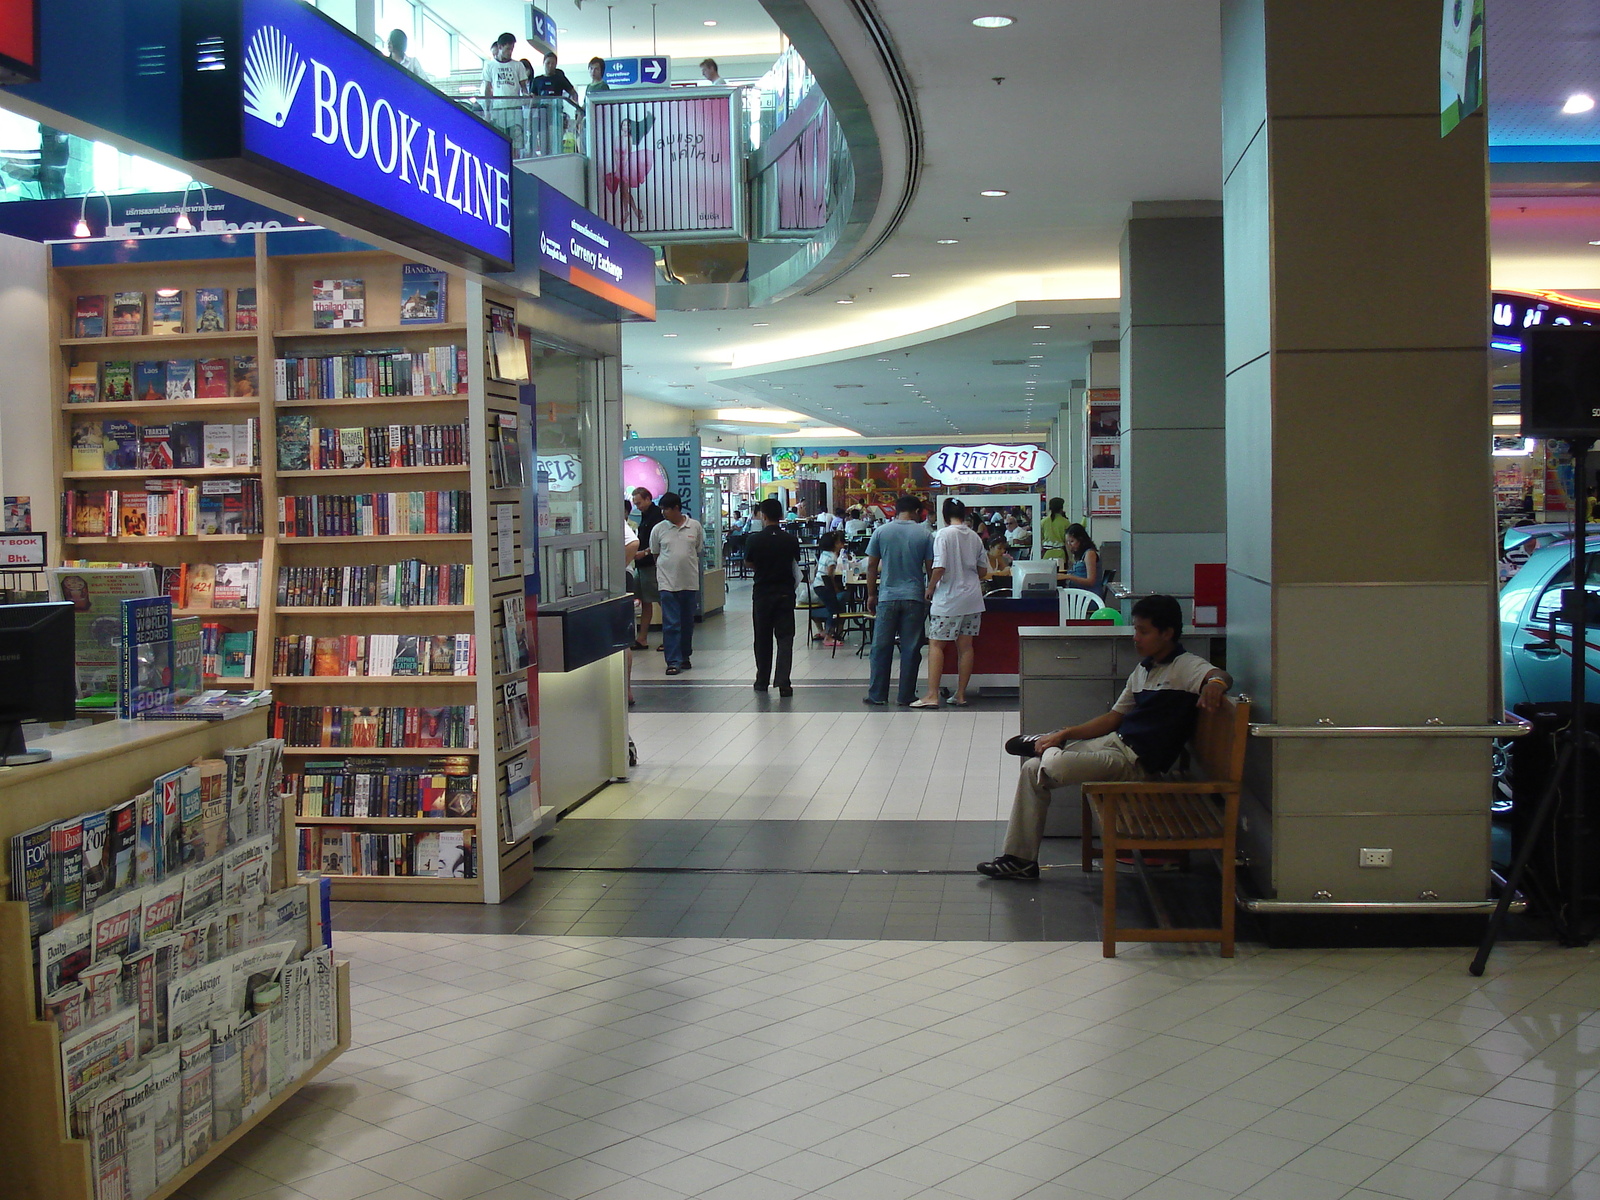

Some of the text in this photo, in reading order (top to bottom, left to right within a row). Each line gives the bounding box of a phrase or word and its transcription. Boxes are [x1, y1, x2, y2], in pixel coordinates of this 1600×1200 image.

[310, 58, 511, 238] BOOKAZINE
[570, 238, 597, 270] Currency
[598, 253, 623, 282] Exchange
[677, 443, 692, 519] ASHIER
[189, 582, 212, 592] 1421
[135, 604, 168, 618] GUINNESS
[135, 614, 168, 632] WORLD
[135, 628, 168, 643] RECORDS
[146, 900, 174, 926] Sun
[98, 918, 129, 943] Sun
